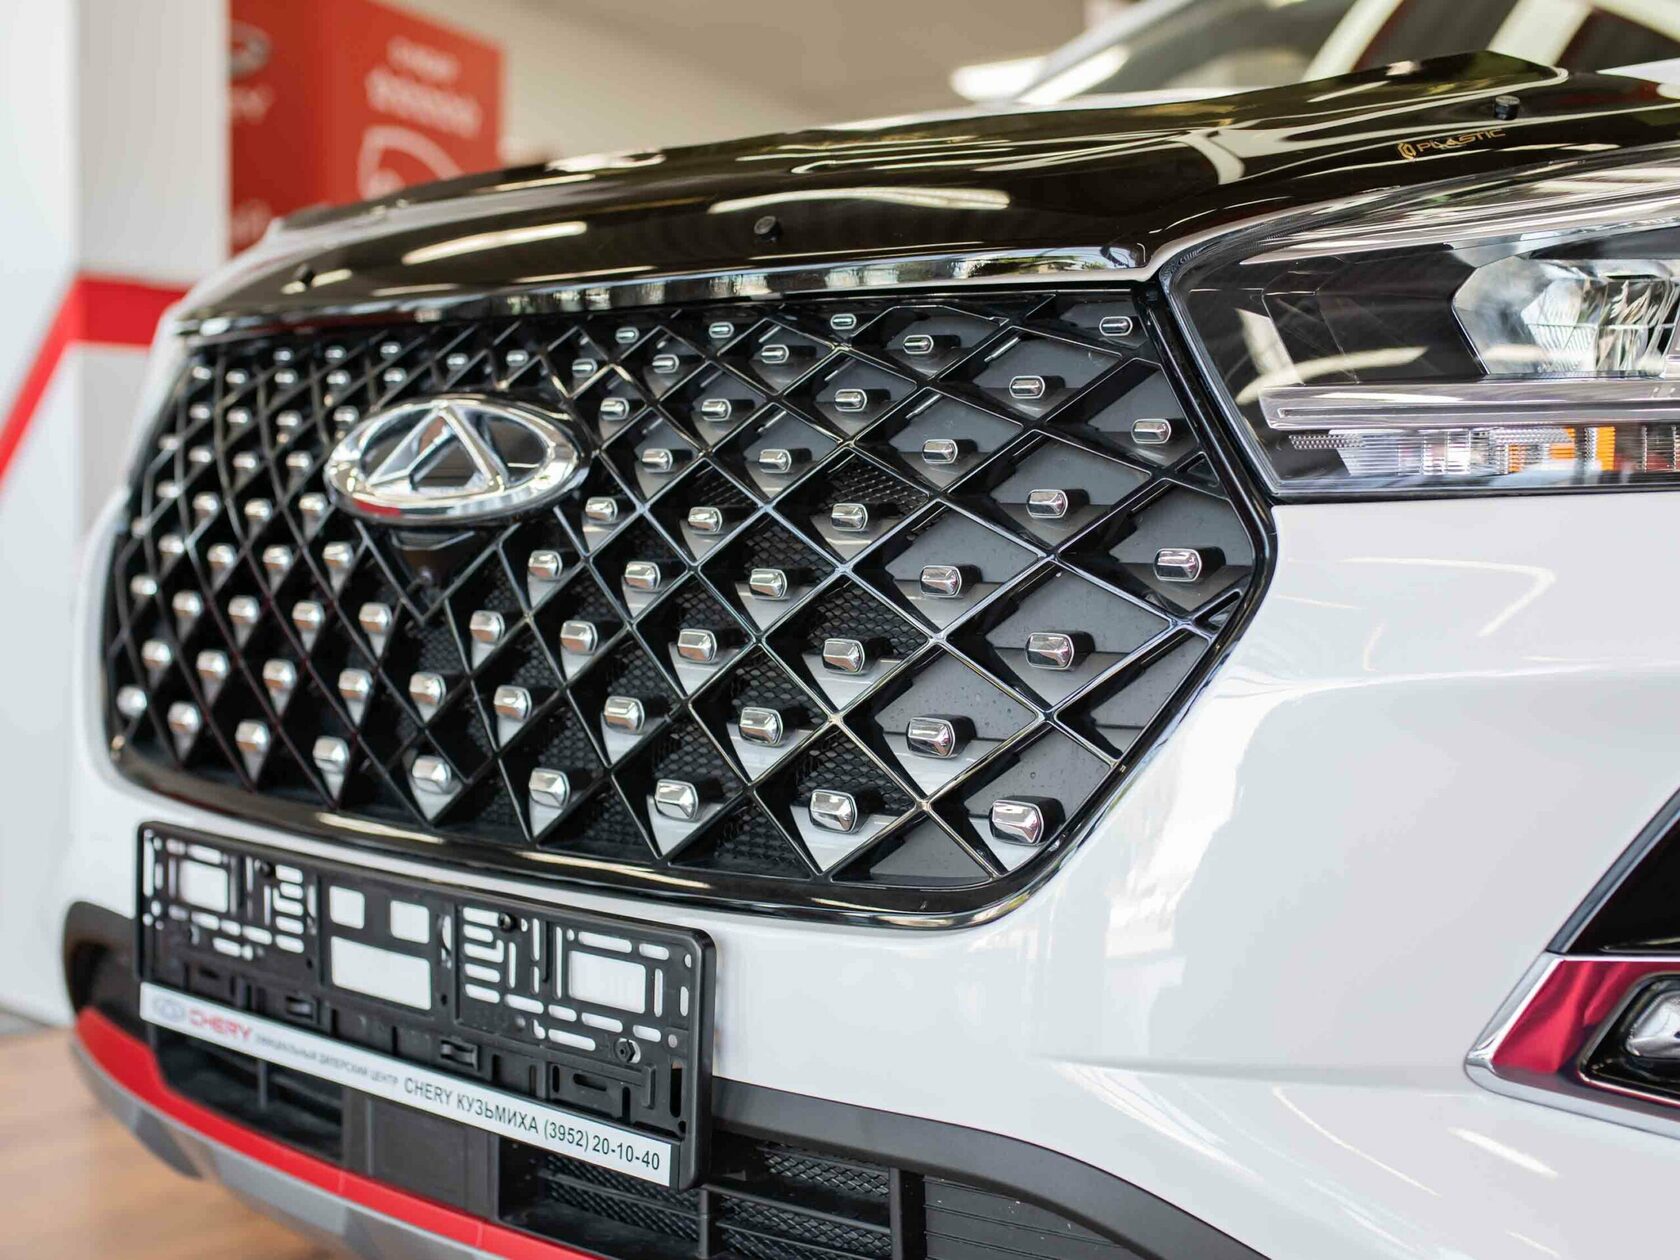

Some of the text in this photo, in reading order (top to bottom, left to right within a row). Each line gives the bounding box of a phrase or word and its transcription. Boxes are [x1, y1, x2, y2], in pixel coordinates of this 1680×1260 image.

[188, 1008, 252, 1040] CHERY
[404, 1077, 660, 1170] CHERY КУЗЬМИХА (3952) 20-10-40
